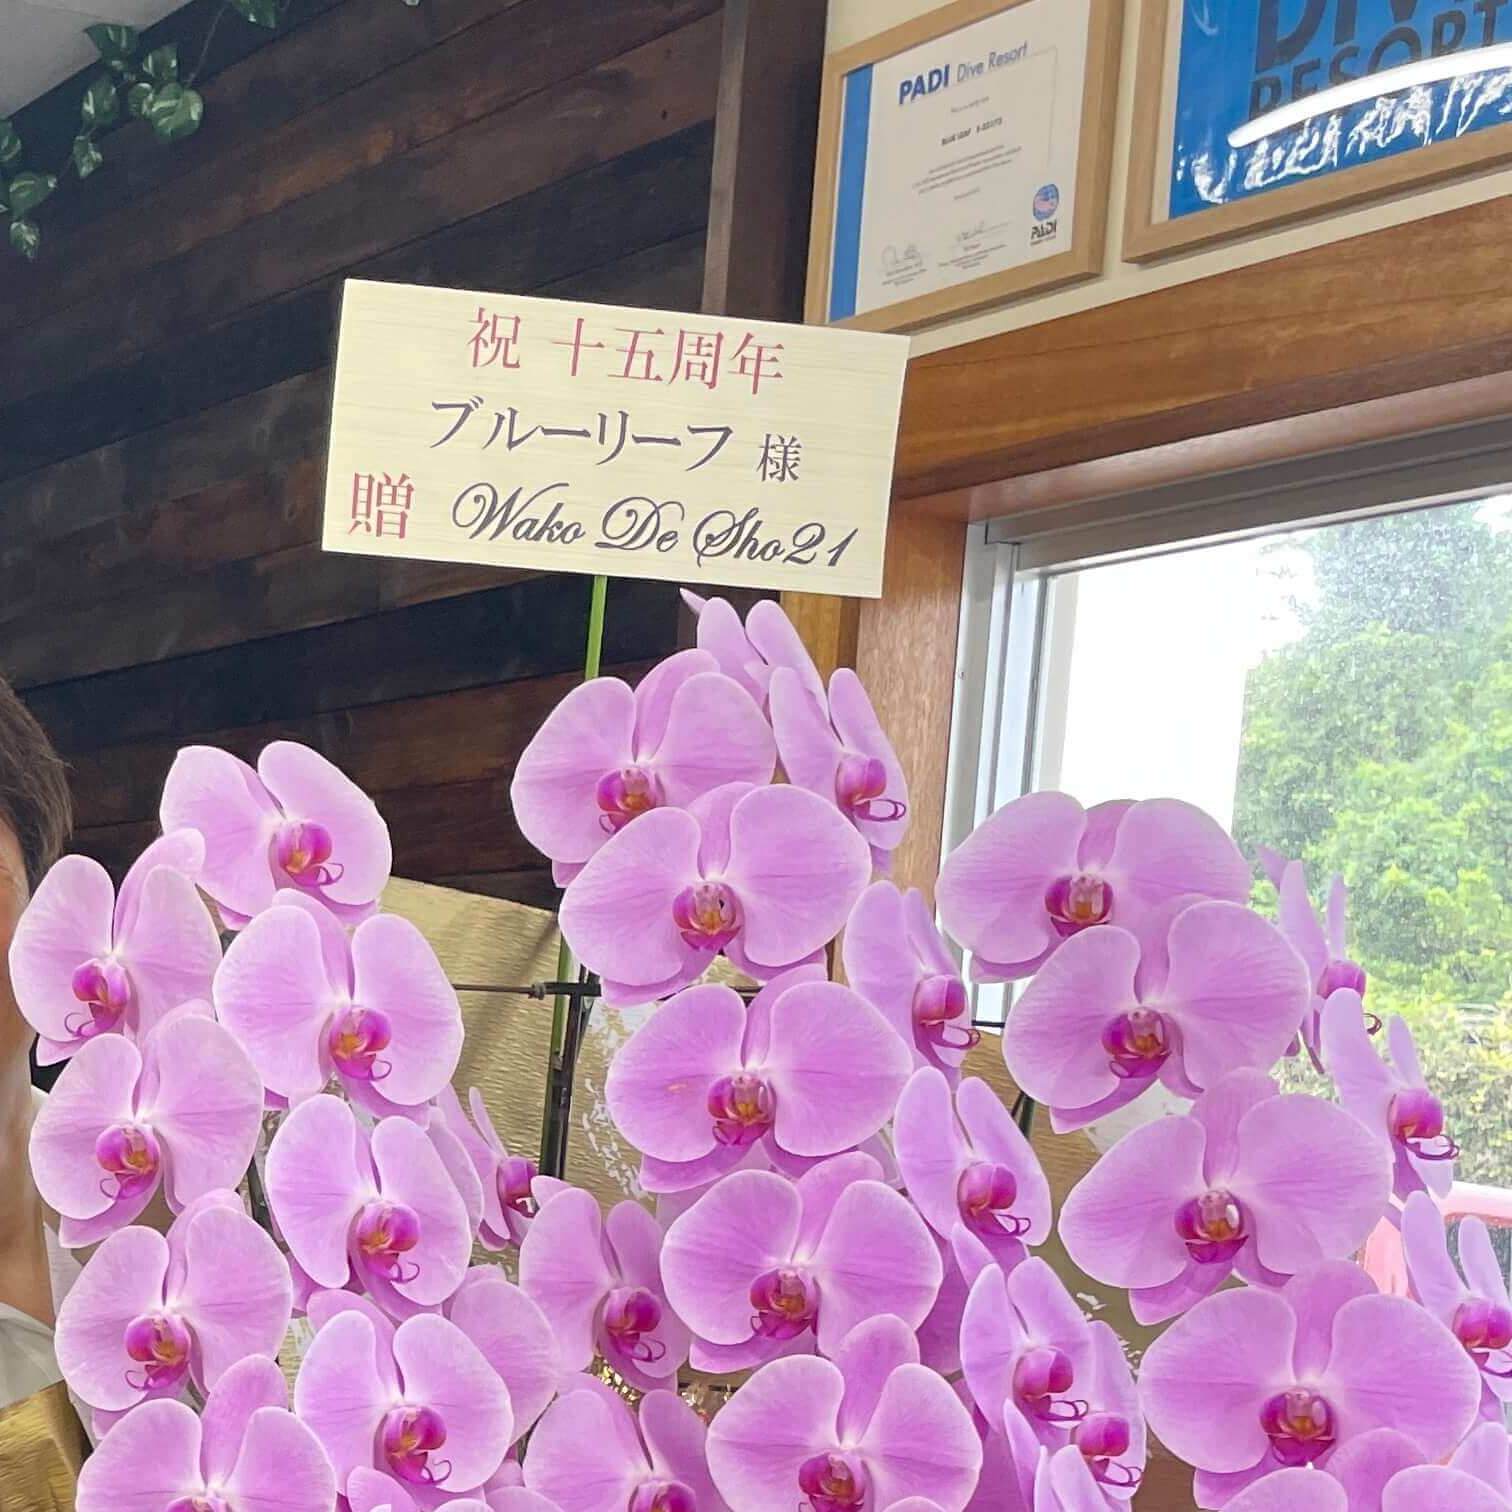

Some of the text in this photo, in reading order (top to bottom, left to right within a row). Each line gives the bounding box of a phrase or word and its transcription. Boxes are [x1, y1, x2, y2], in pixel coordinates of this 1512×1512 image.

[898, 64, 950, 105] PADI
[957, 61, 984, 83] Dive
[988, 41, 1028, 69] Resort
[1030, 221, 1057, 240] PADI
[467, 307, 785, 394] 祝 十五周年
[429, 396, 803, 483] ブルーリーフ 様
[347, 472, 859, 568] 贈 Wako De Sho21
